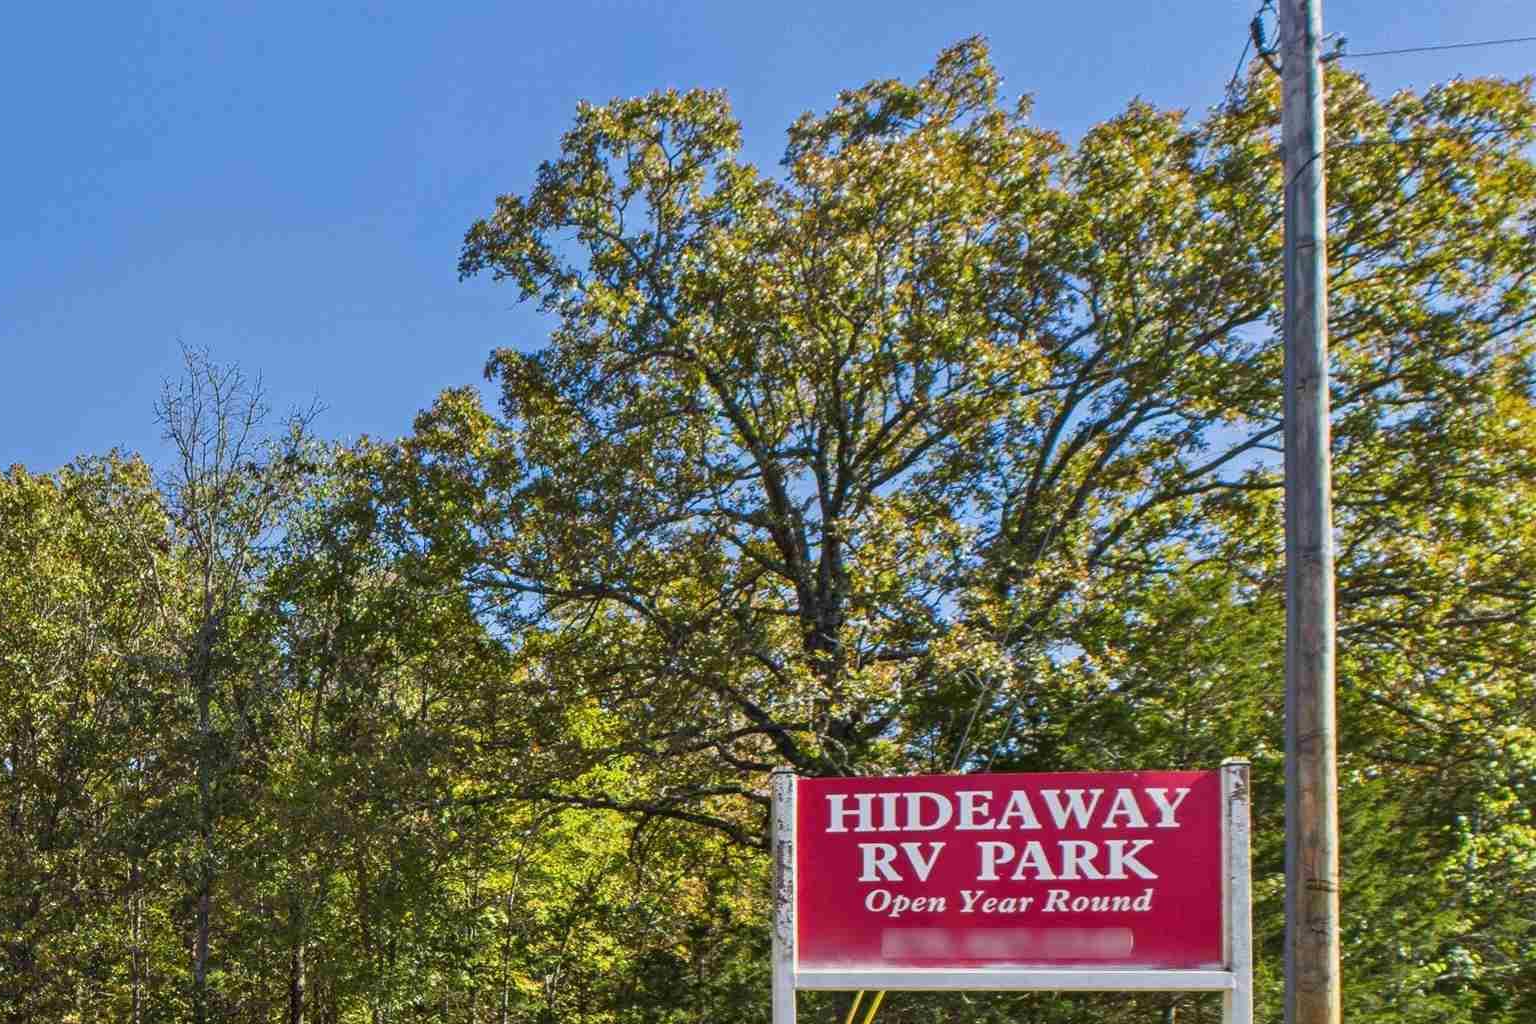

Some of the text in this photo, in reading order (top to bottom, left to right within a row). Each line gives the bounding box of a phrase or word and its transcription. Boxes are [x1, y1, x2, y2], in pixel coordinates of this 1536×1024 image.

[824, 787, 1191, 833] HIDEAWAY
[858, 839, 1158, 882] RV PARK
[864, 887, 1154, 917] Open Year Round
